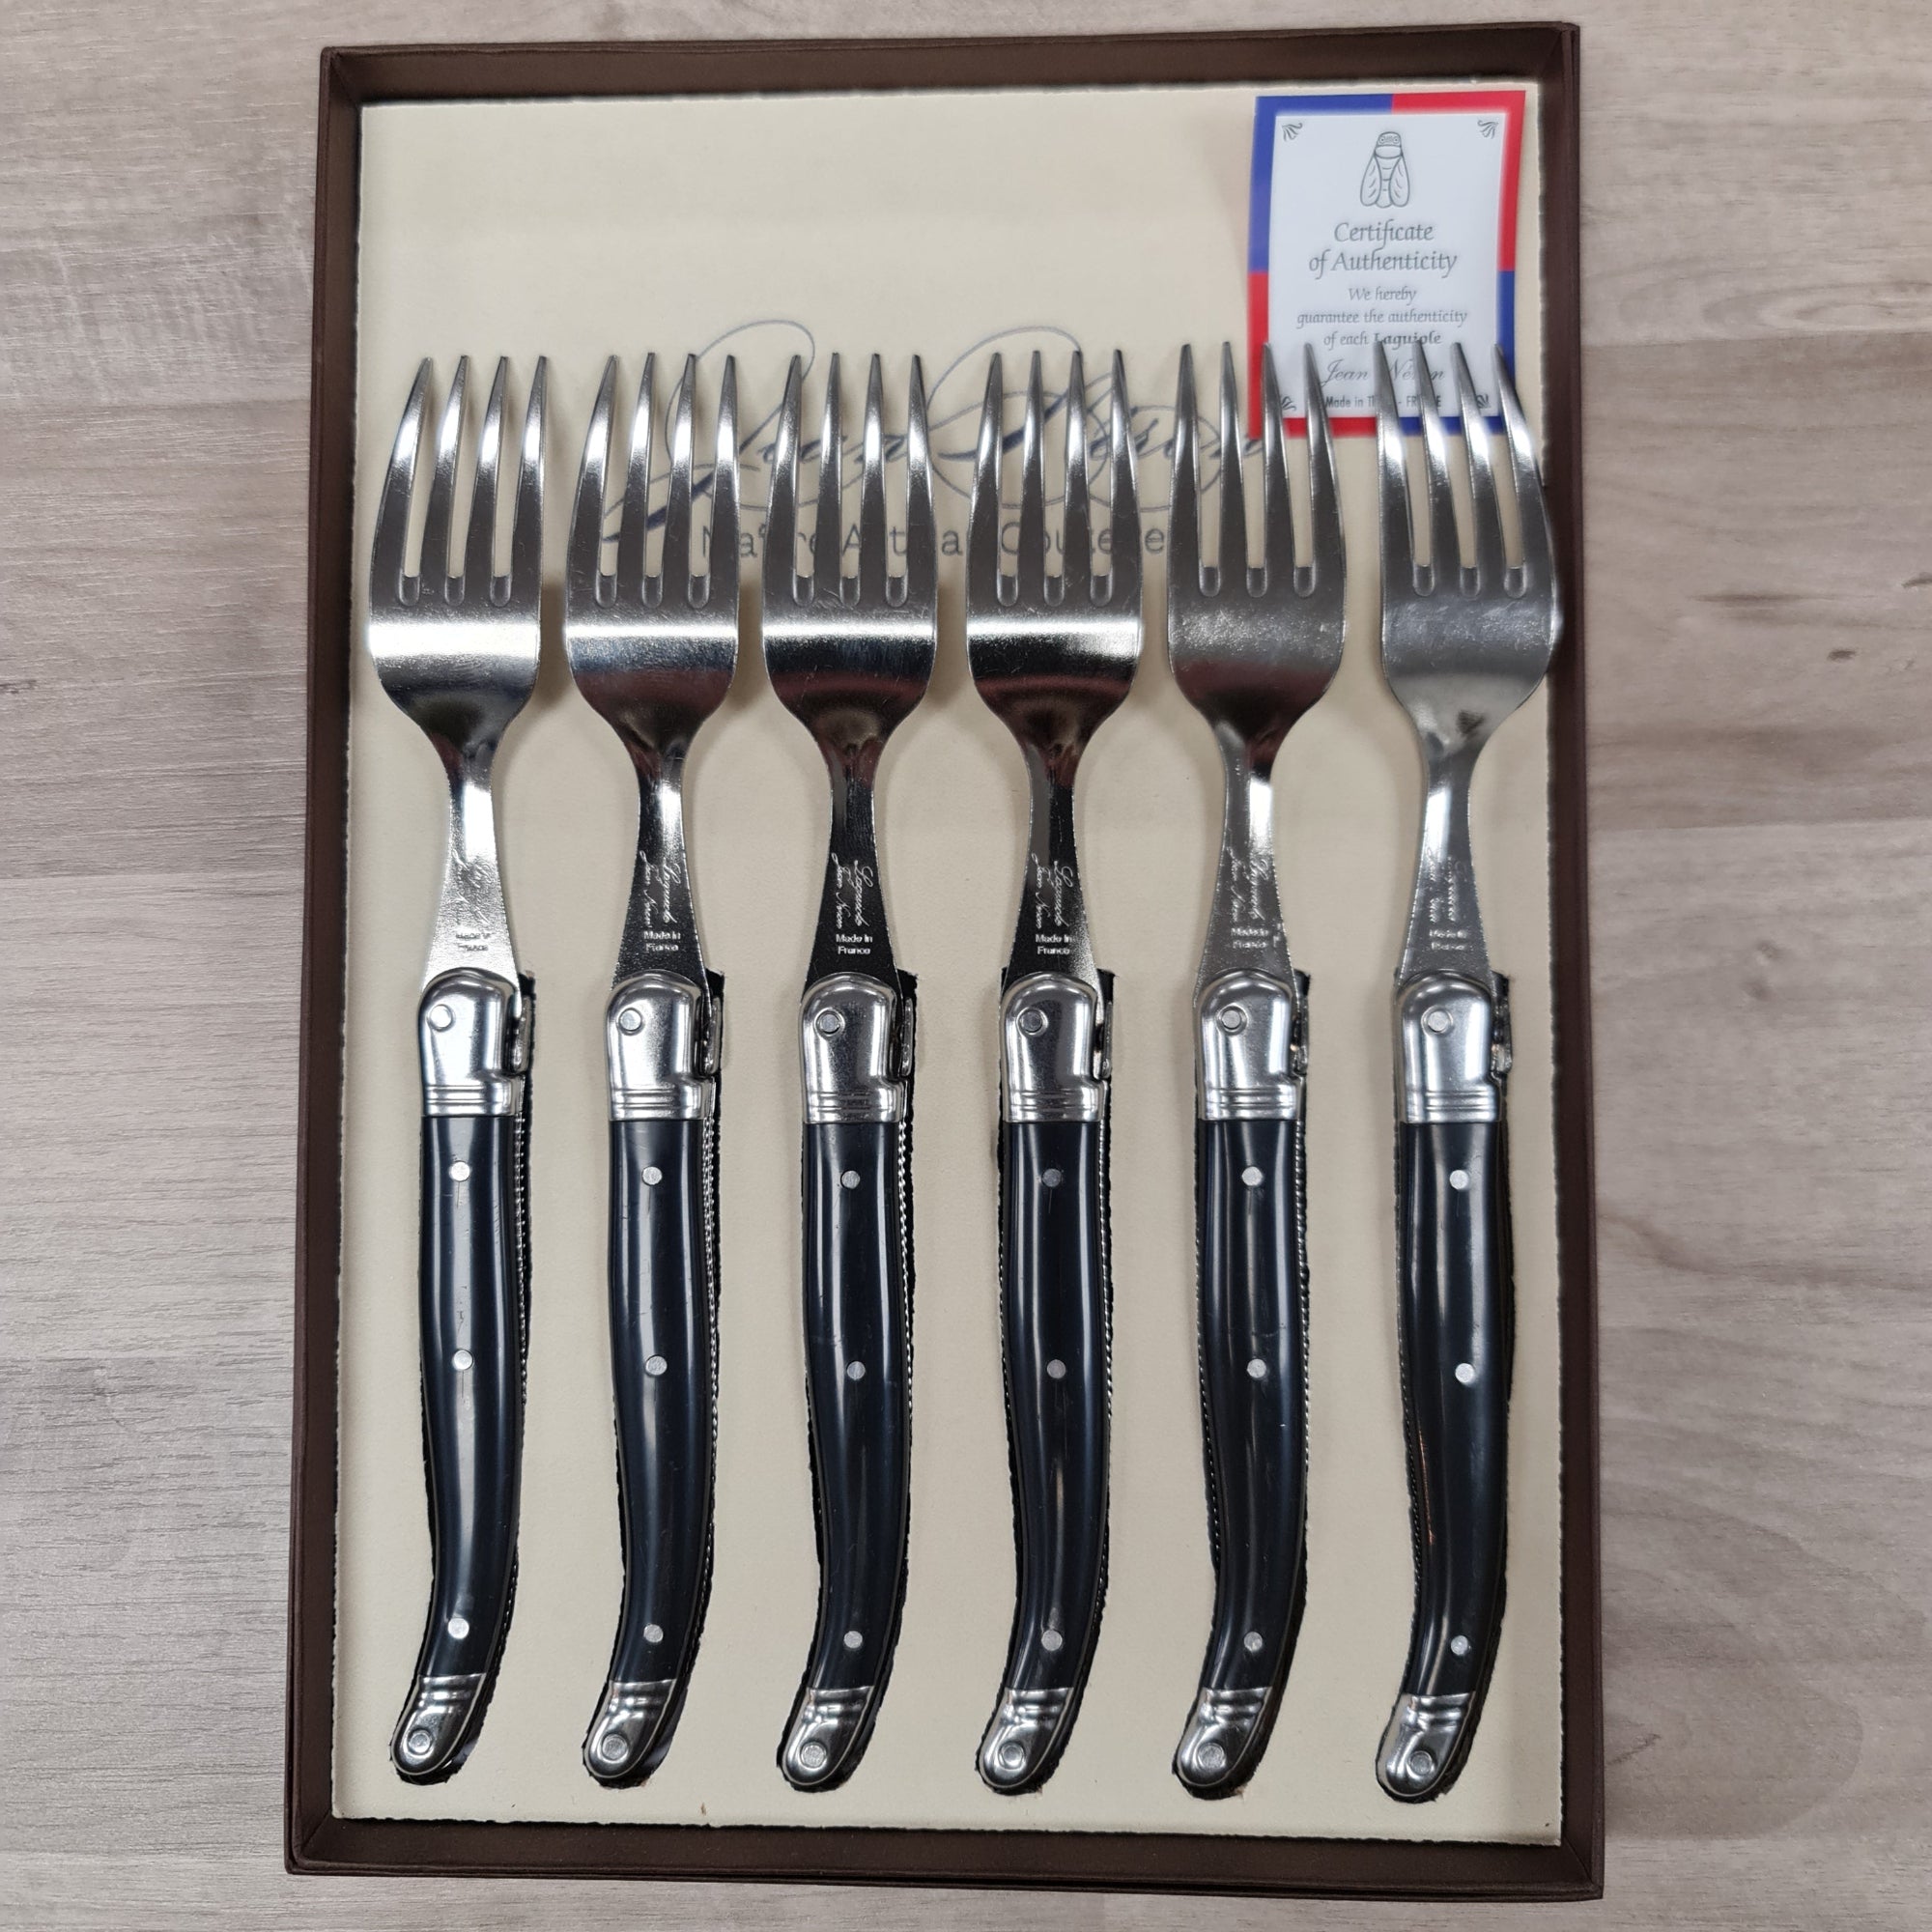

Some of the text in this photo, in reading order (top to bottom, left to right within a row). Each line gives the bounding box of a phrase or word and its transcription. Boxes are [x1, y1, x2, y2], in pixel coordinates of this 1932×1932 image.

[1334, 218, 1435, 249] Certificate
[1309, 249, 1458, 280] of Authenticity
[1349, 286, 1417, 306] We hereby
[1296, 308, 1468, 329] guarantee the authenticity
[1323, 330, 1338, 351] of
[1340, 330, 1370, 346] each
[1324, 395, 1350, 408] Made
[1354, 395, 1364, 408] in
